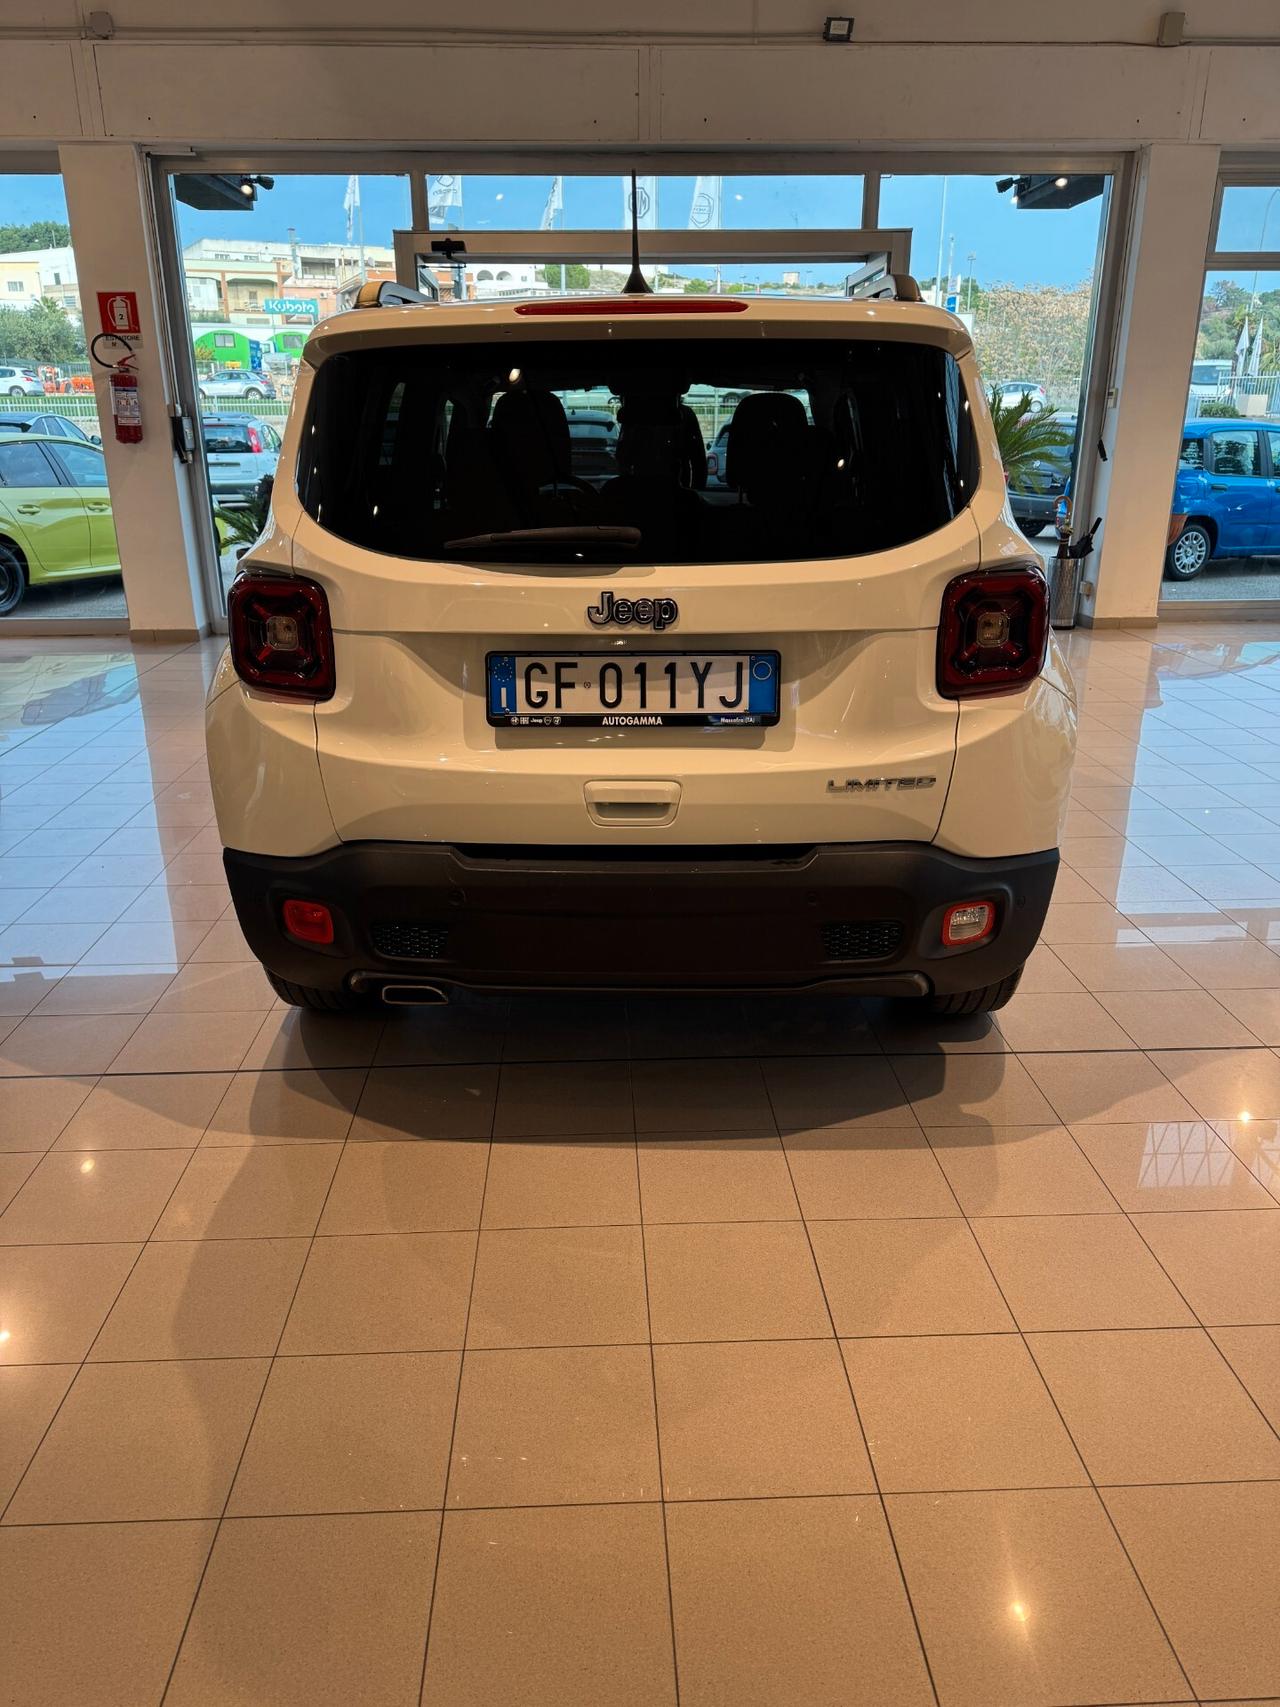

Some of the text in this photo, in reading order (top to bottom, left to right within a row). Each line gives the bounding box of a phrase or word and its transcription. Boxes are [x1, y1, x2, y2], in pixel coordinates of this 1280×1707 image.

[268, 300, 315, 312] Kubota
[587, 591, 678, 630] Jeep
[524, 662, 743, 709] GF 011YJ
[602, 716, 663, 726] AUTOGAMMA
[825, 775, 936, 793] LIMITED
